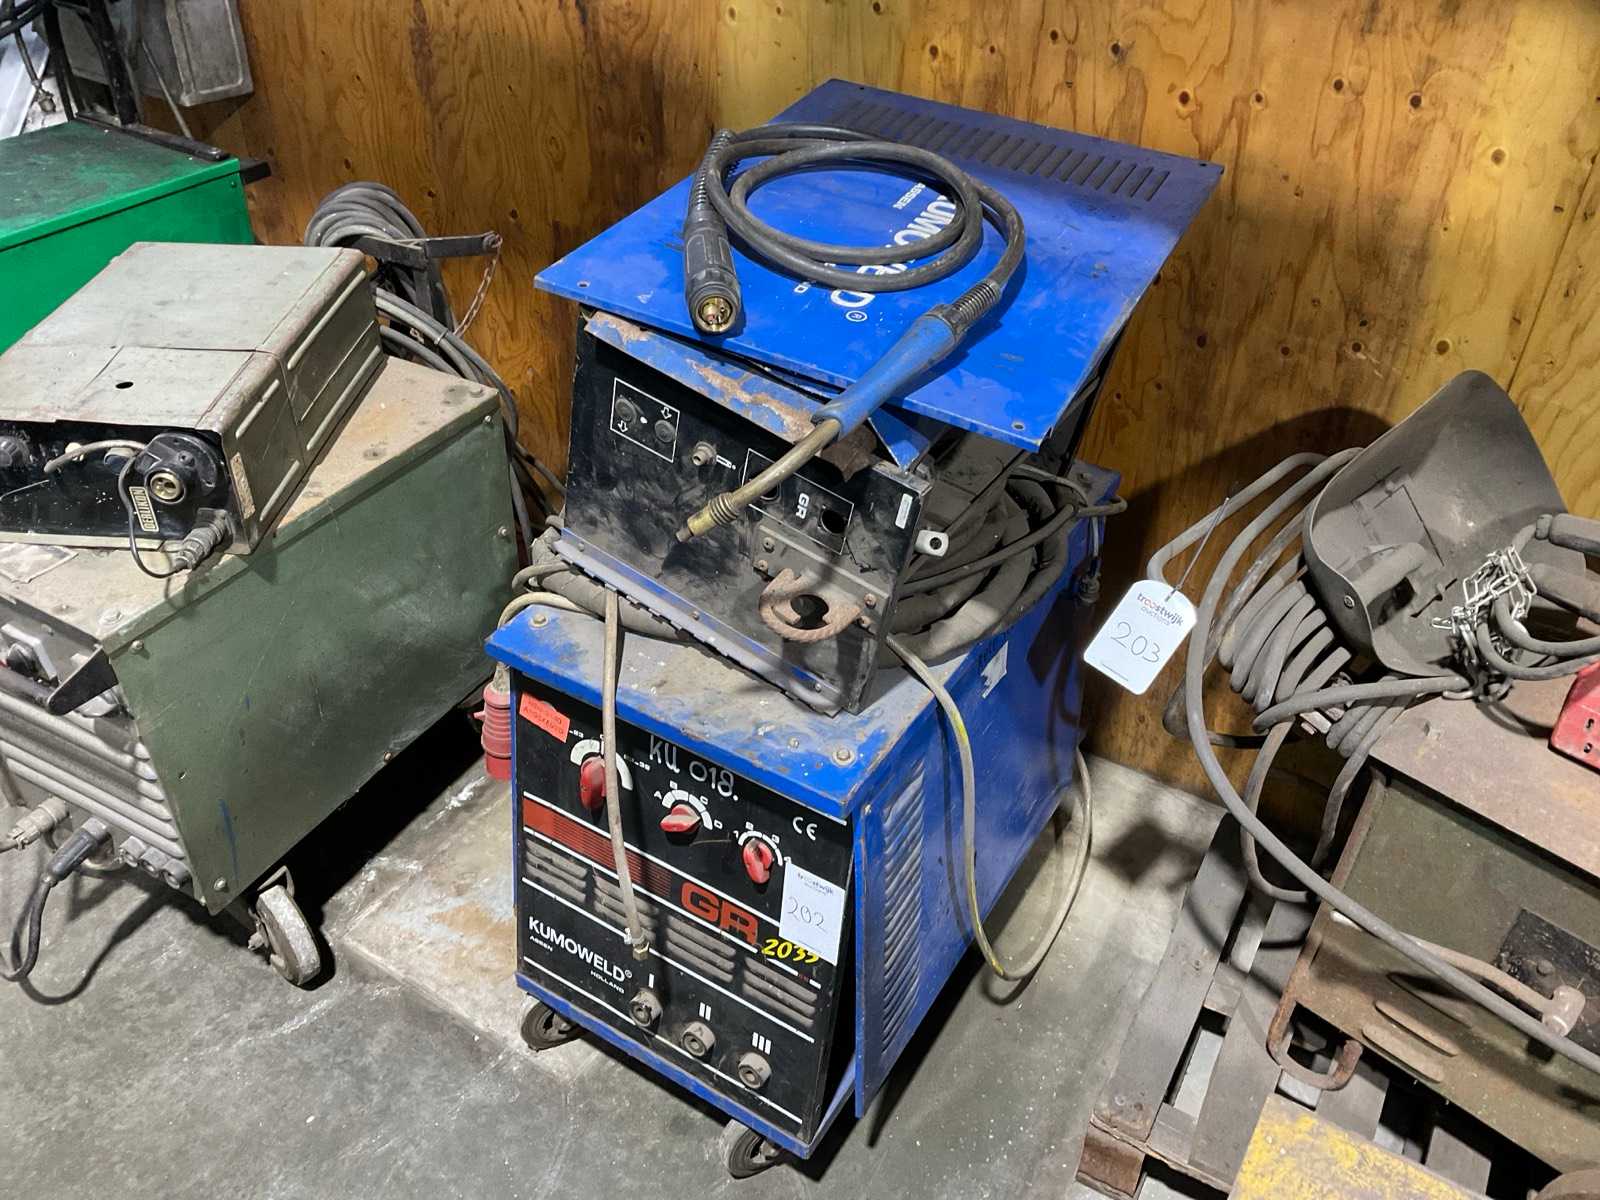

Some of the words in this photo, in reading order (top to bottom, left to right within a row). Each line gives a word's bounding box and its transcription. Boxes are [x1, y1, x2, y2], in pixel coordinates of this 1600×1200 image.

[796, 492, 811, 520] GR
[1136, 592, 1185, 627] troostwijk
[1110, 621, 1161, 663] 203
[681, 881, 759, 946] GR
[786, 896, 828, 936] 202
[590, 970, 625, 994] HOLLAND
